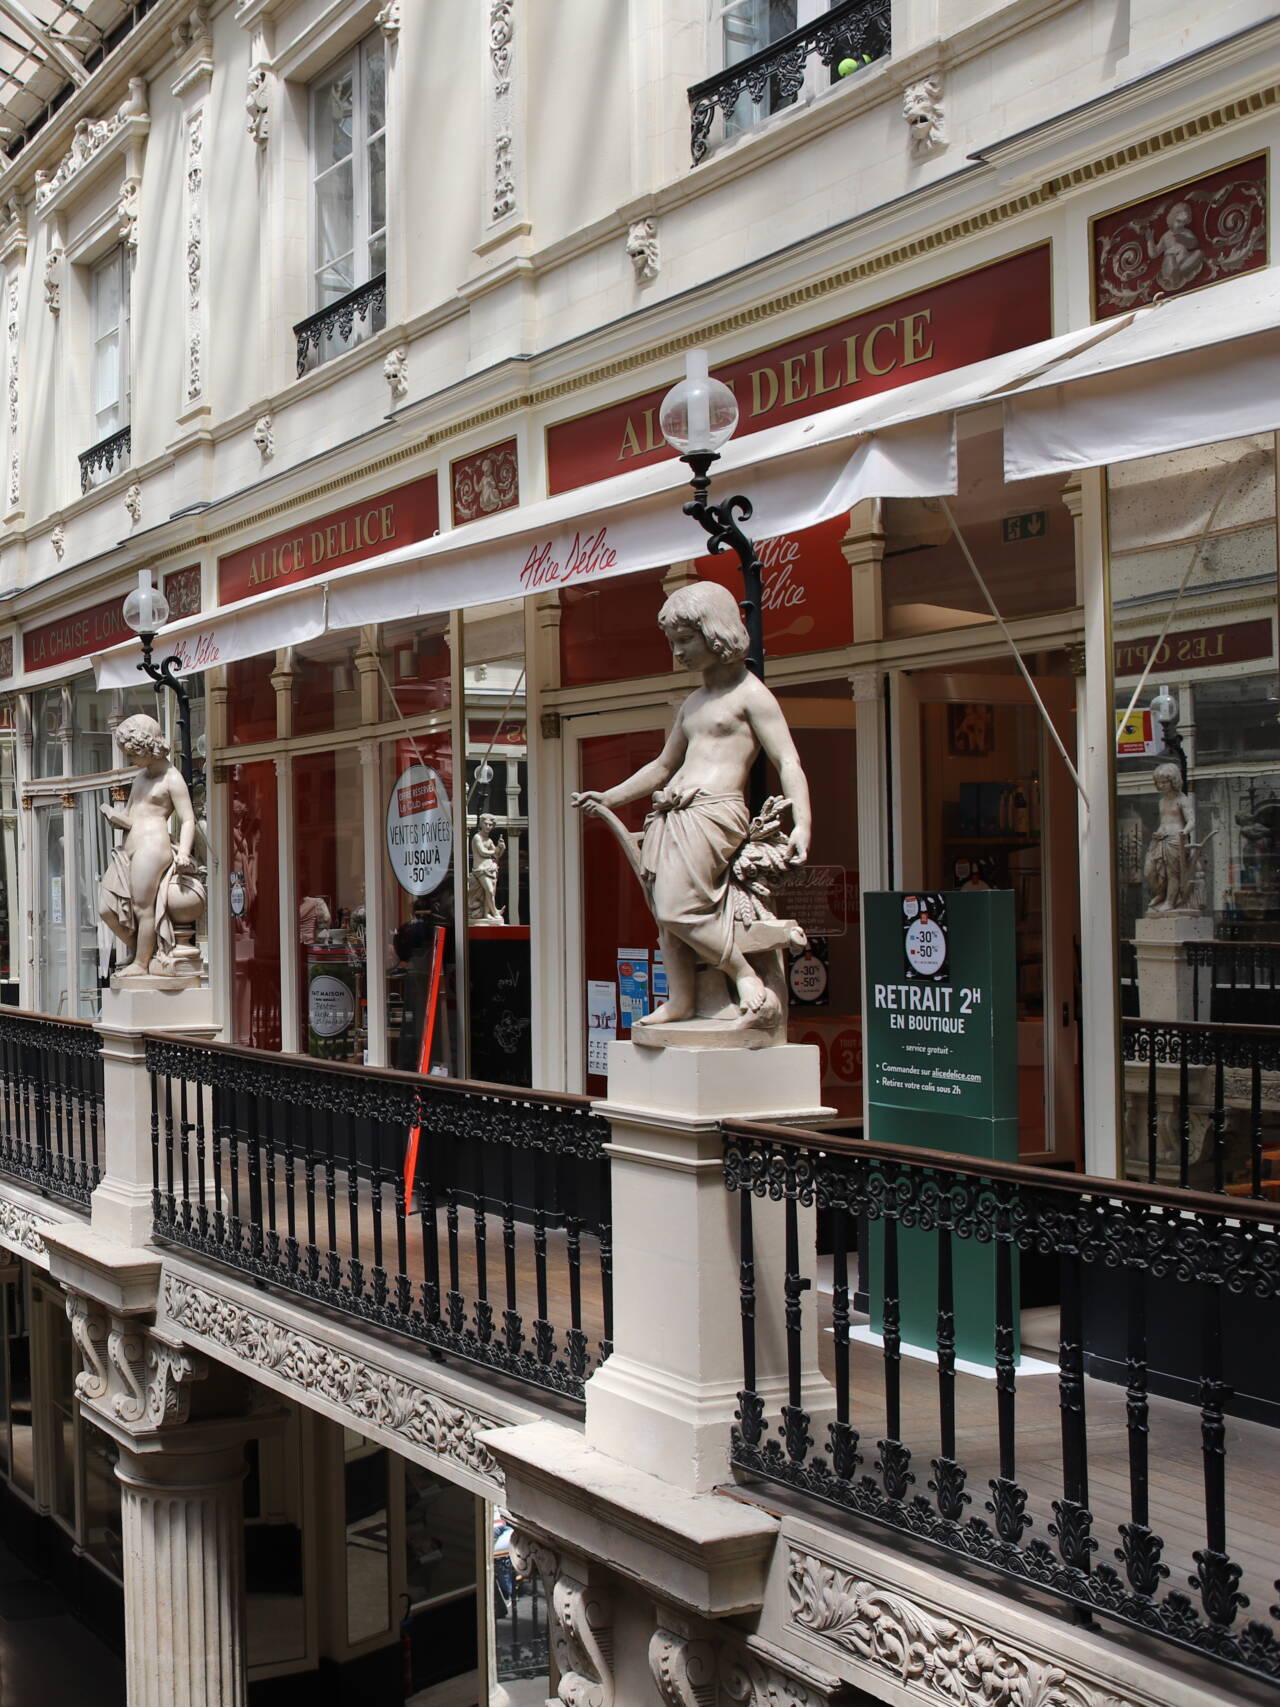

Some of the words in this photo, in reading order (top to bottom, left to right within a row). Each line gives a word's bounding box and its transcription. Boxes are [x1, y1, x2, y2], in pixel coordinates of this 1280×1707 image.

[749, 308, 934, 418] DELICE
[248, 537, 305, 587] ALICE
[310, 504, 396, 565] DELICE
[520, 541, 560, 590] Alice
[561, 526, 618, 582] Délice
[761, 564, 807, 610] élice
[32, 638, 46, 662] LA
[49, 619, 89, 656] CHAISE
[389, 824, 419, 845] VENTES
[421, 817, 450, 843] PRIVÉES
[404, 845, 441, 866] JUSQU'À
[874, 984, 953, 1013] RETRAIT
[890, 1014, 905, 1029] EN
[908, 1015, 965, 1034] BOUTIQUE
[906, 1043, 926, 1053] service
[927, 1045, 949, 1056] gratuit
[882, 1062, 920, 1075] Commandez
[931, 1068, 981, 1082] alicedelice.com
[882, 1077, 903, 1088] Retirez
[904, 1080, 920, 1090] votre
[921, 1082, 935, 1092] colis
[936, 1086, 951, 1094] sous
[952, 1085, 961, 1095] 2h
